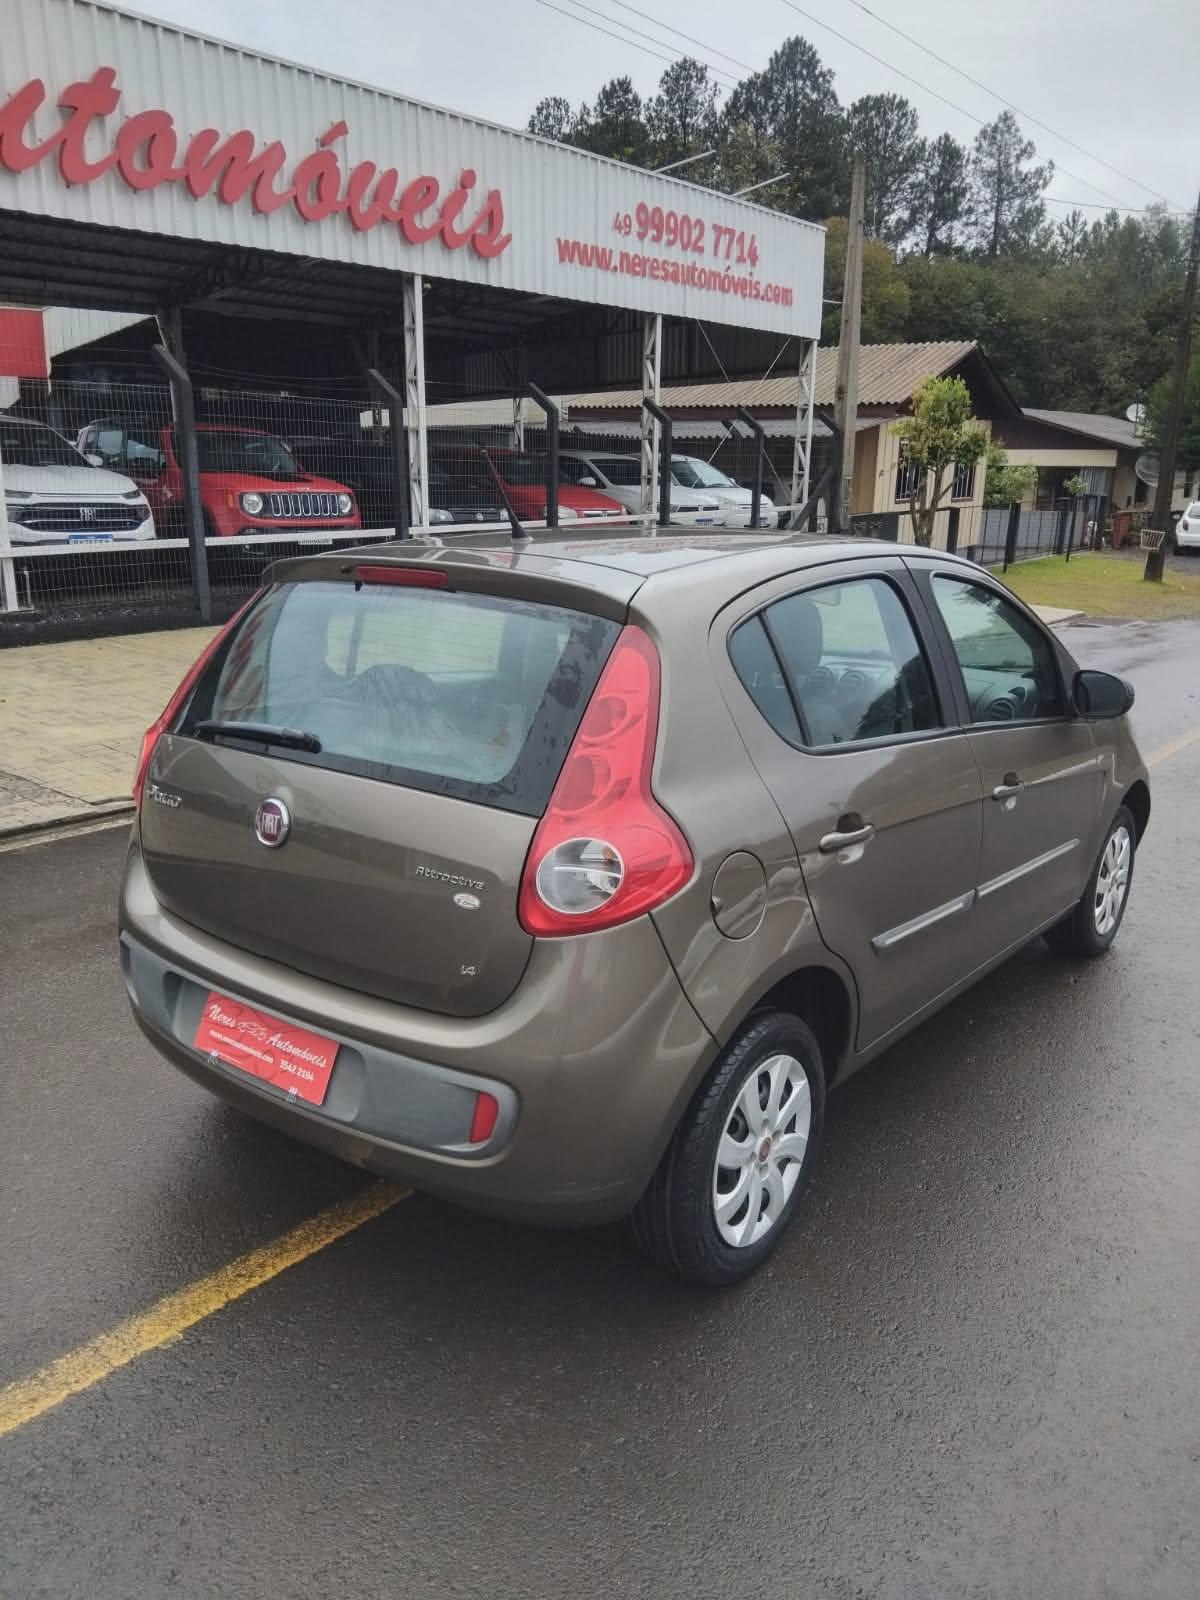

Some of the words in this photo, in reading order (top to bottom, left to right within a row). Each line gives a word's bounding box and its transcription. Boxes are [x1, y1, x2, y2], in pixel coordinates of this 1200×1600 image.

[613, 212, 632, 236] 49
[635, 201, 706, 254] 99902
[711, 223, 760, 268] 7714
[556, 237, 794, 307] www.neresautomóveis.com
[262, 812, 280, 834] FIAT
